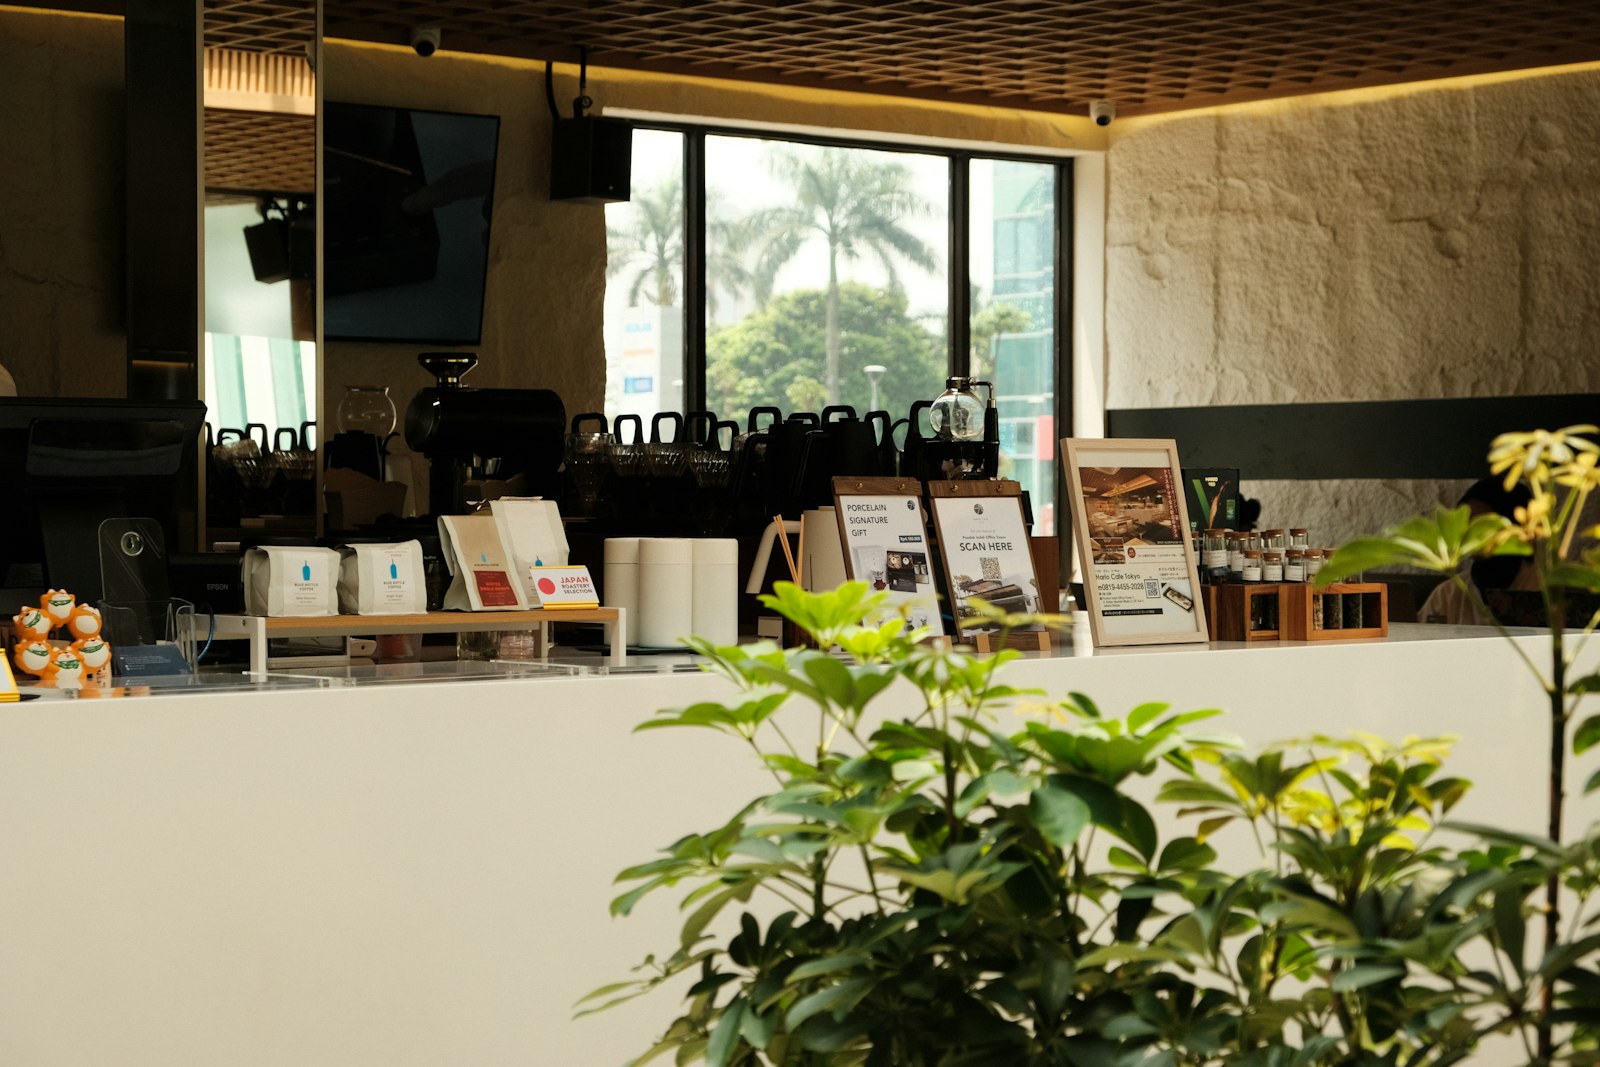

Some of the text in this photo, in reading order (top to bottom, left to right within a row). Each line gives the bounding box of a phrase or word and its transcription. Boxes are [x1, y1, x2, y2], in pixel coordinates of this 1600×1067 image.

[847, 504, 887, 512] PORCELAIN
[849, 516, 888, 524] SIGNATURE
[851, 529, 867, 537] GIFT
[960, 542, 1013, 551] SCAN HERE
